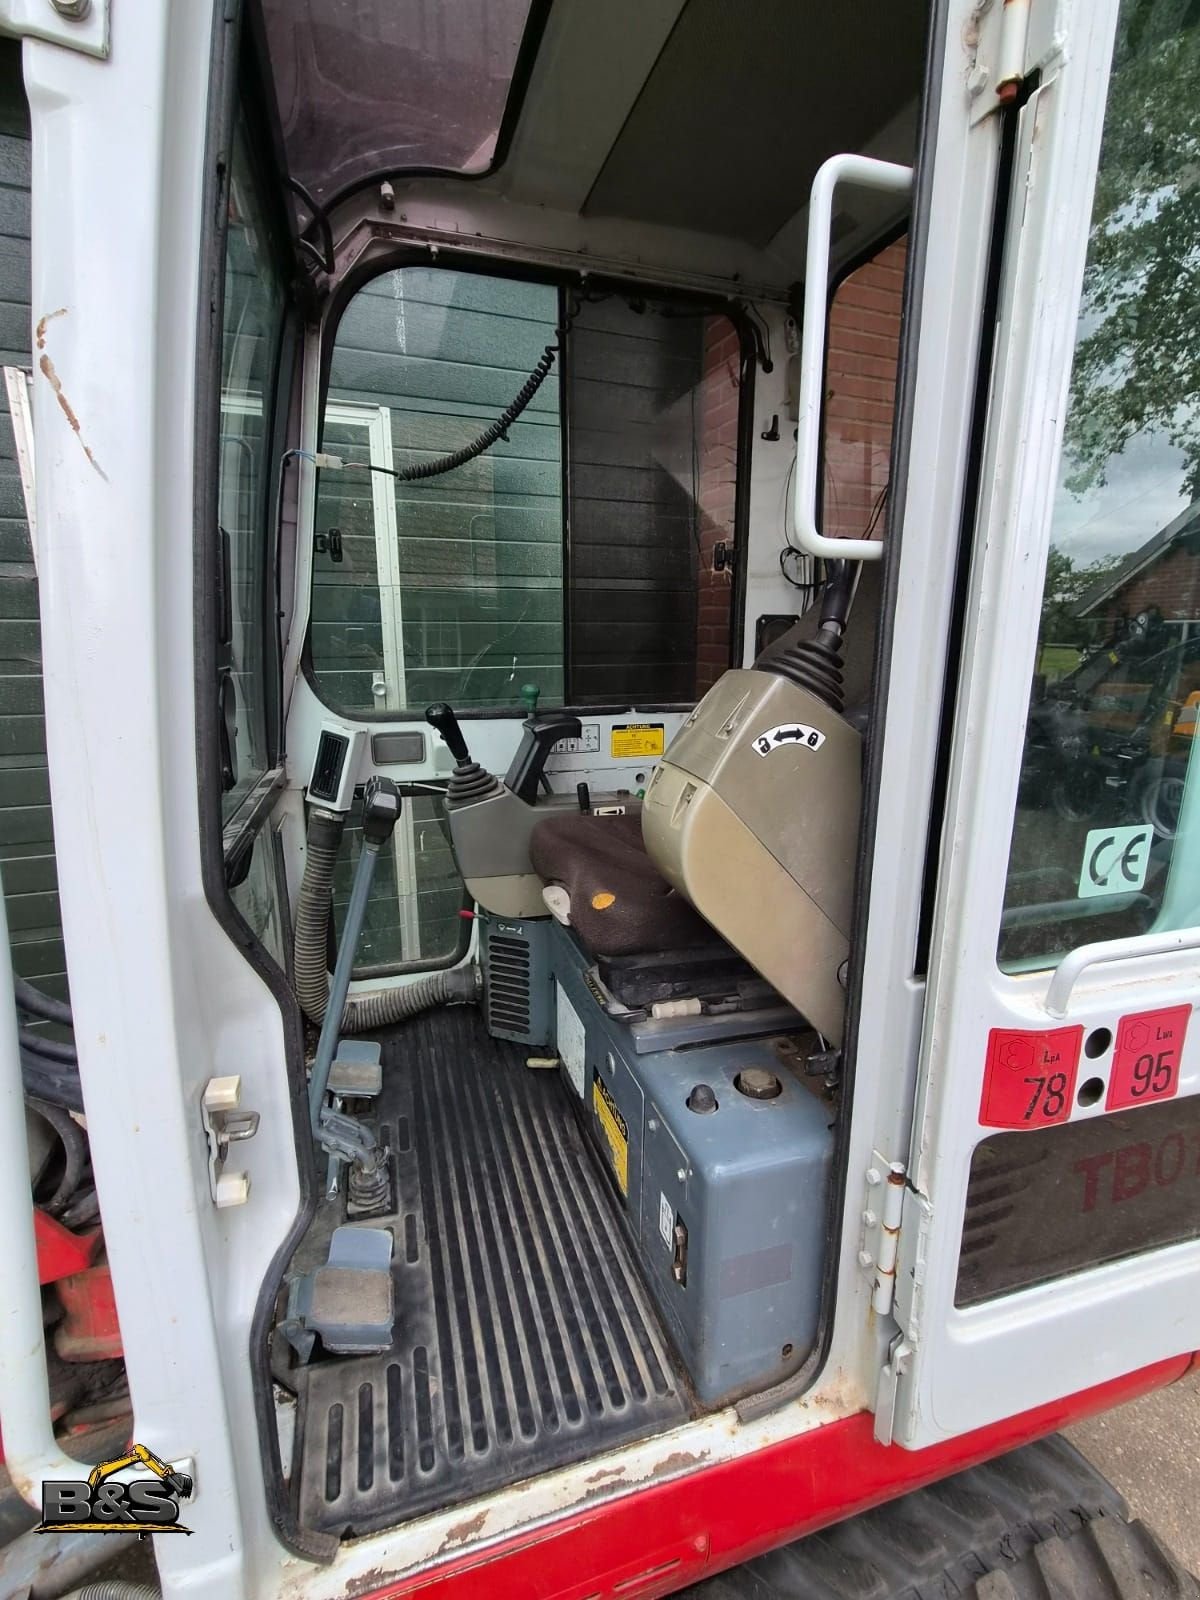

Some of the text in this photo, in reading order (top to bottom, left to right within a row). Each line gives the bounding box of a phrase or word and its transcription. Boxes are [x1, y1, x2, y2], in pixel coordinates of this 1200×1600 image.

[1089, 832, 1147, 886] CE
[1023, 1072, 1067, 1121] 78
[1130, 1050, 1174, 1097] 95
[596, 1075, 627, 1137] ACHTUNG
